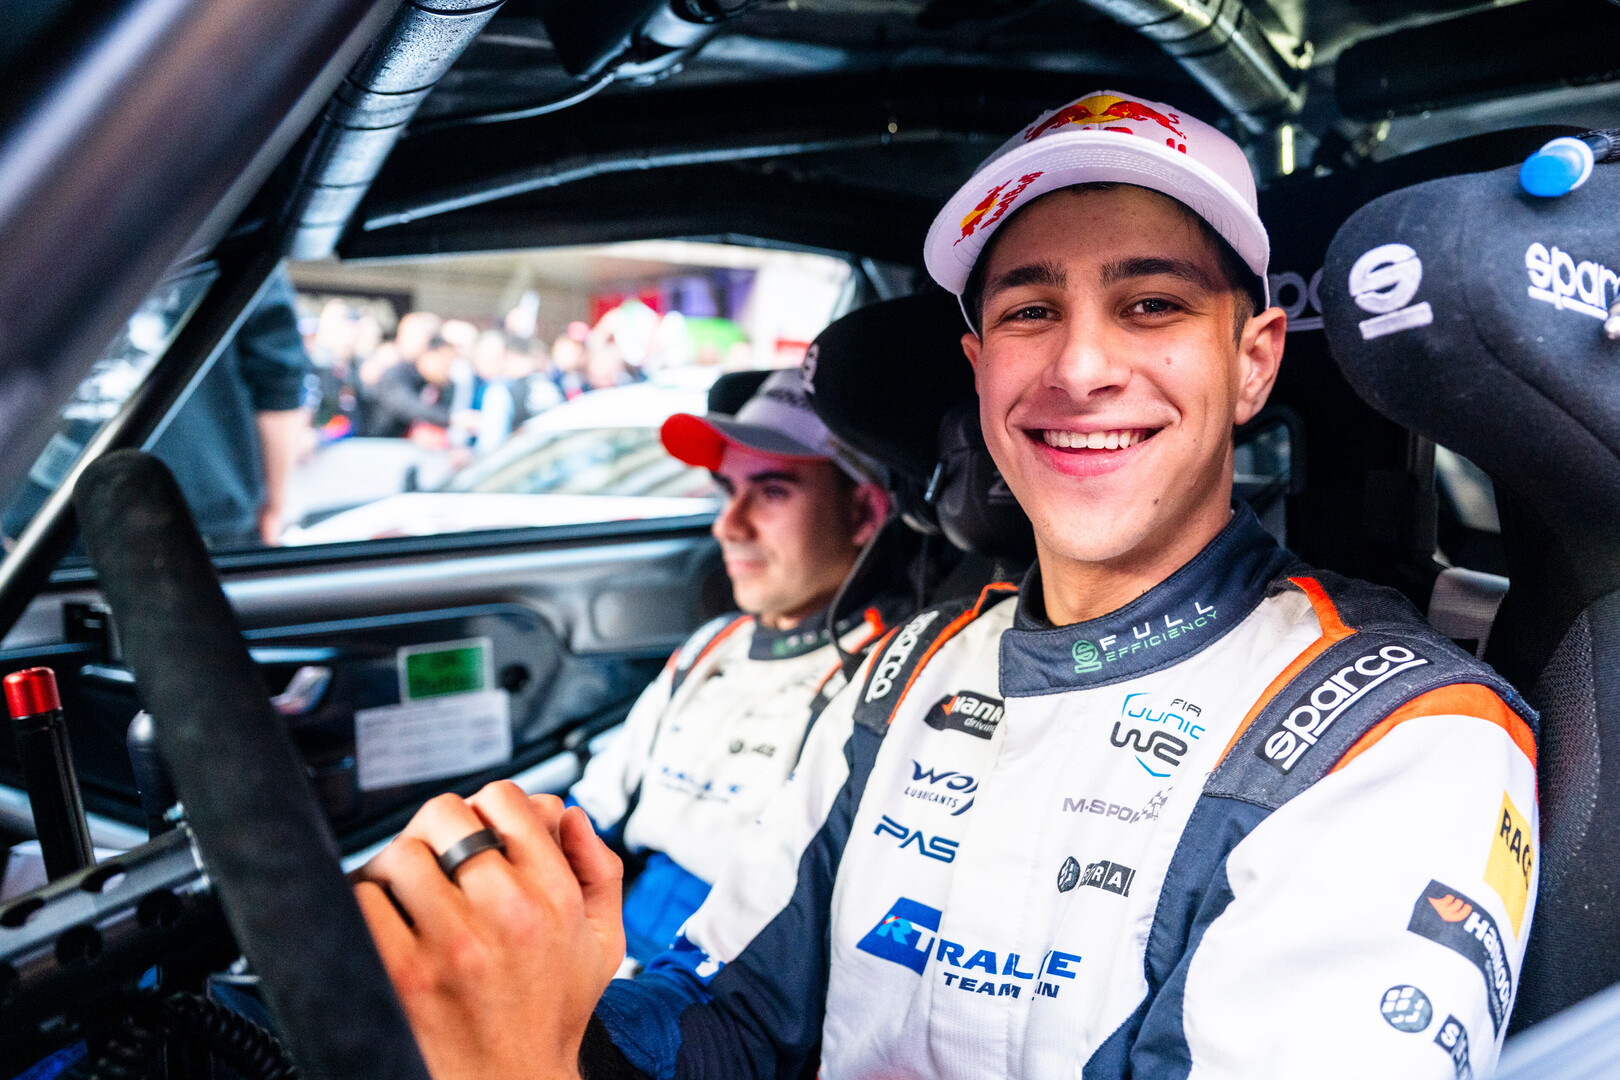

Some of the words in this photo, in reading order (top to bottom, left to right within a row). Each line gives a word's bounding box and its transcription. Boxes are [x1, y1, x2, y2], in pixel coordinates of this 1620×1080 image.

[1525, 242, 1619, 312] spar
[1099, 602, 1213, 651] FULL
[1105, 610, 1217, 662] EFFICIENCY
[1170, 698, 1202, 717] FIA
[1264, 645, 1422, 765] sparco
[903, 786, 959, 808] LUBRICANTS
[943, 971, 1022, 999] TEAM
